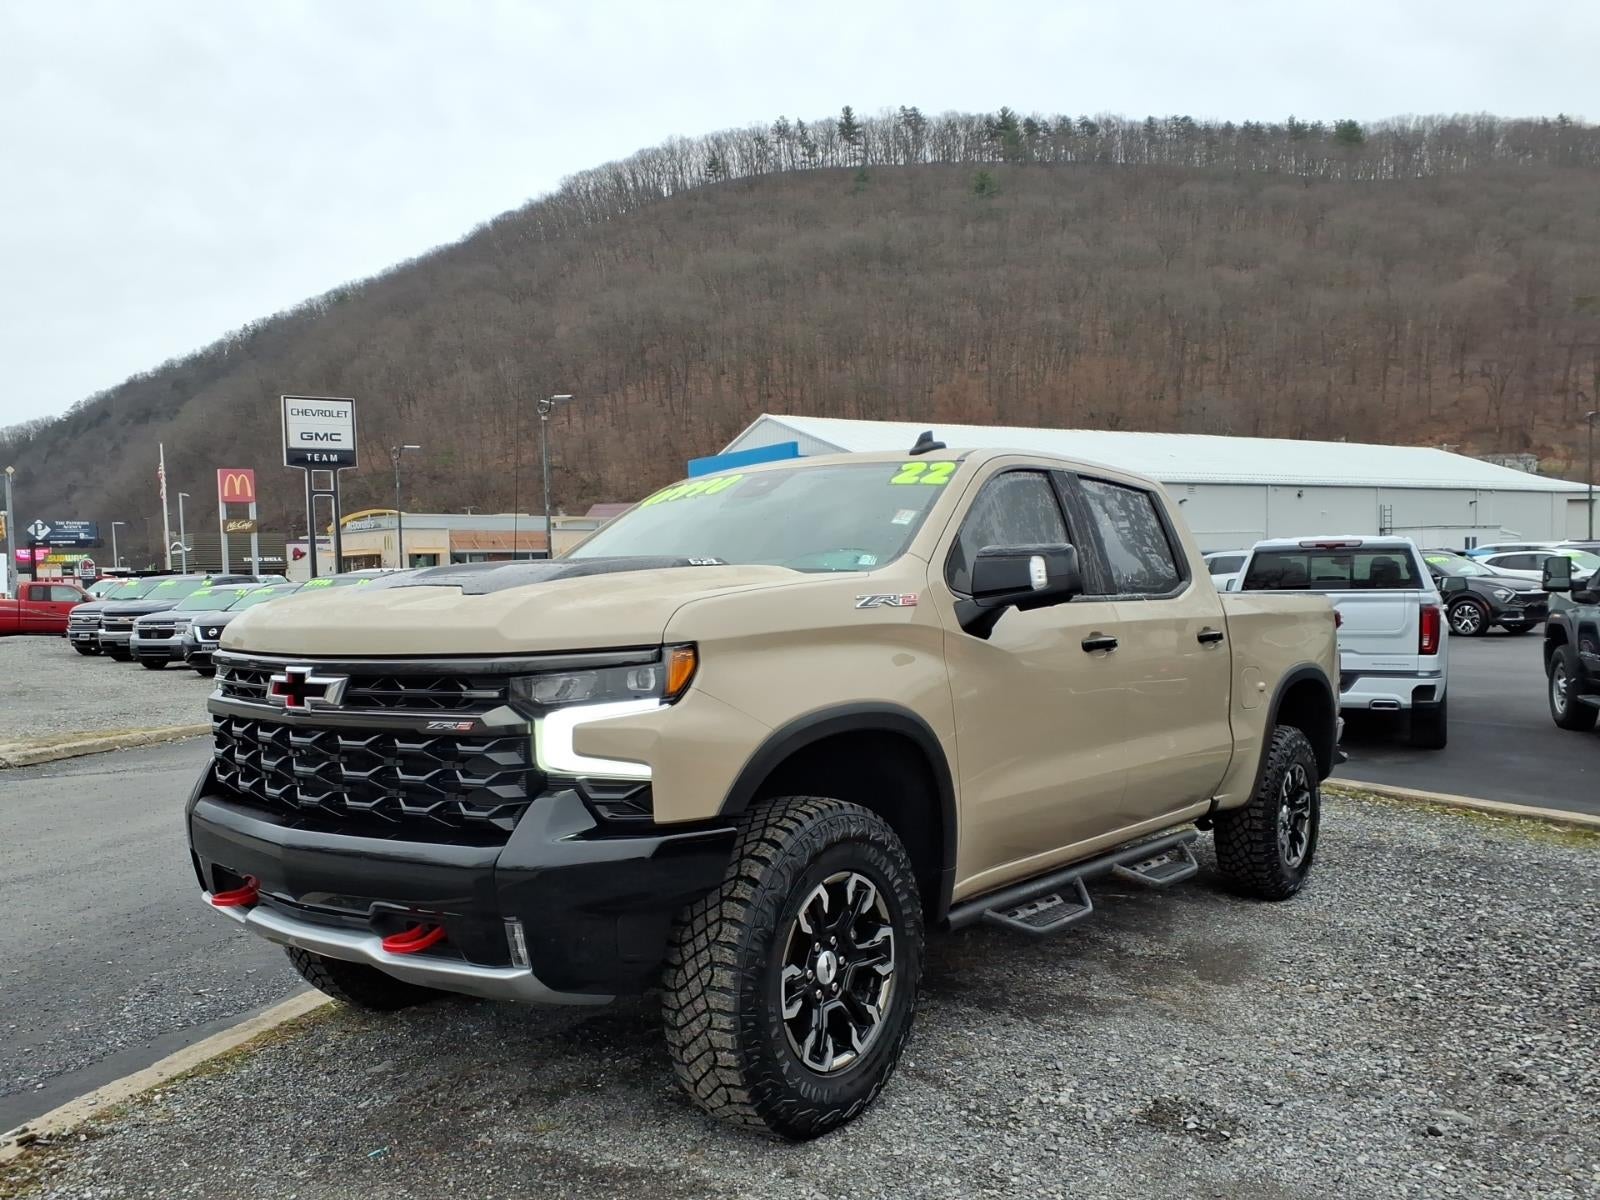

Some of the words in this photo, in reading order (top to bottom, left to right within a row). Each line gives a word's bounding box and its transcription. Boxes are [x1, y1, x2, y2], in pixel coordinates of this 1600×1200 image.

[290, 408, 348, 418] CHEVROLET
[300, 432, 342, 442] GMC
[306, 453, 338, 462] TEAM
[890, 461, 956, 485] 22
[855, 593, 918, 609] ZR2
[426, 721, 474, 730] ZR2
